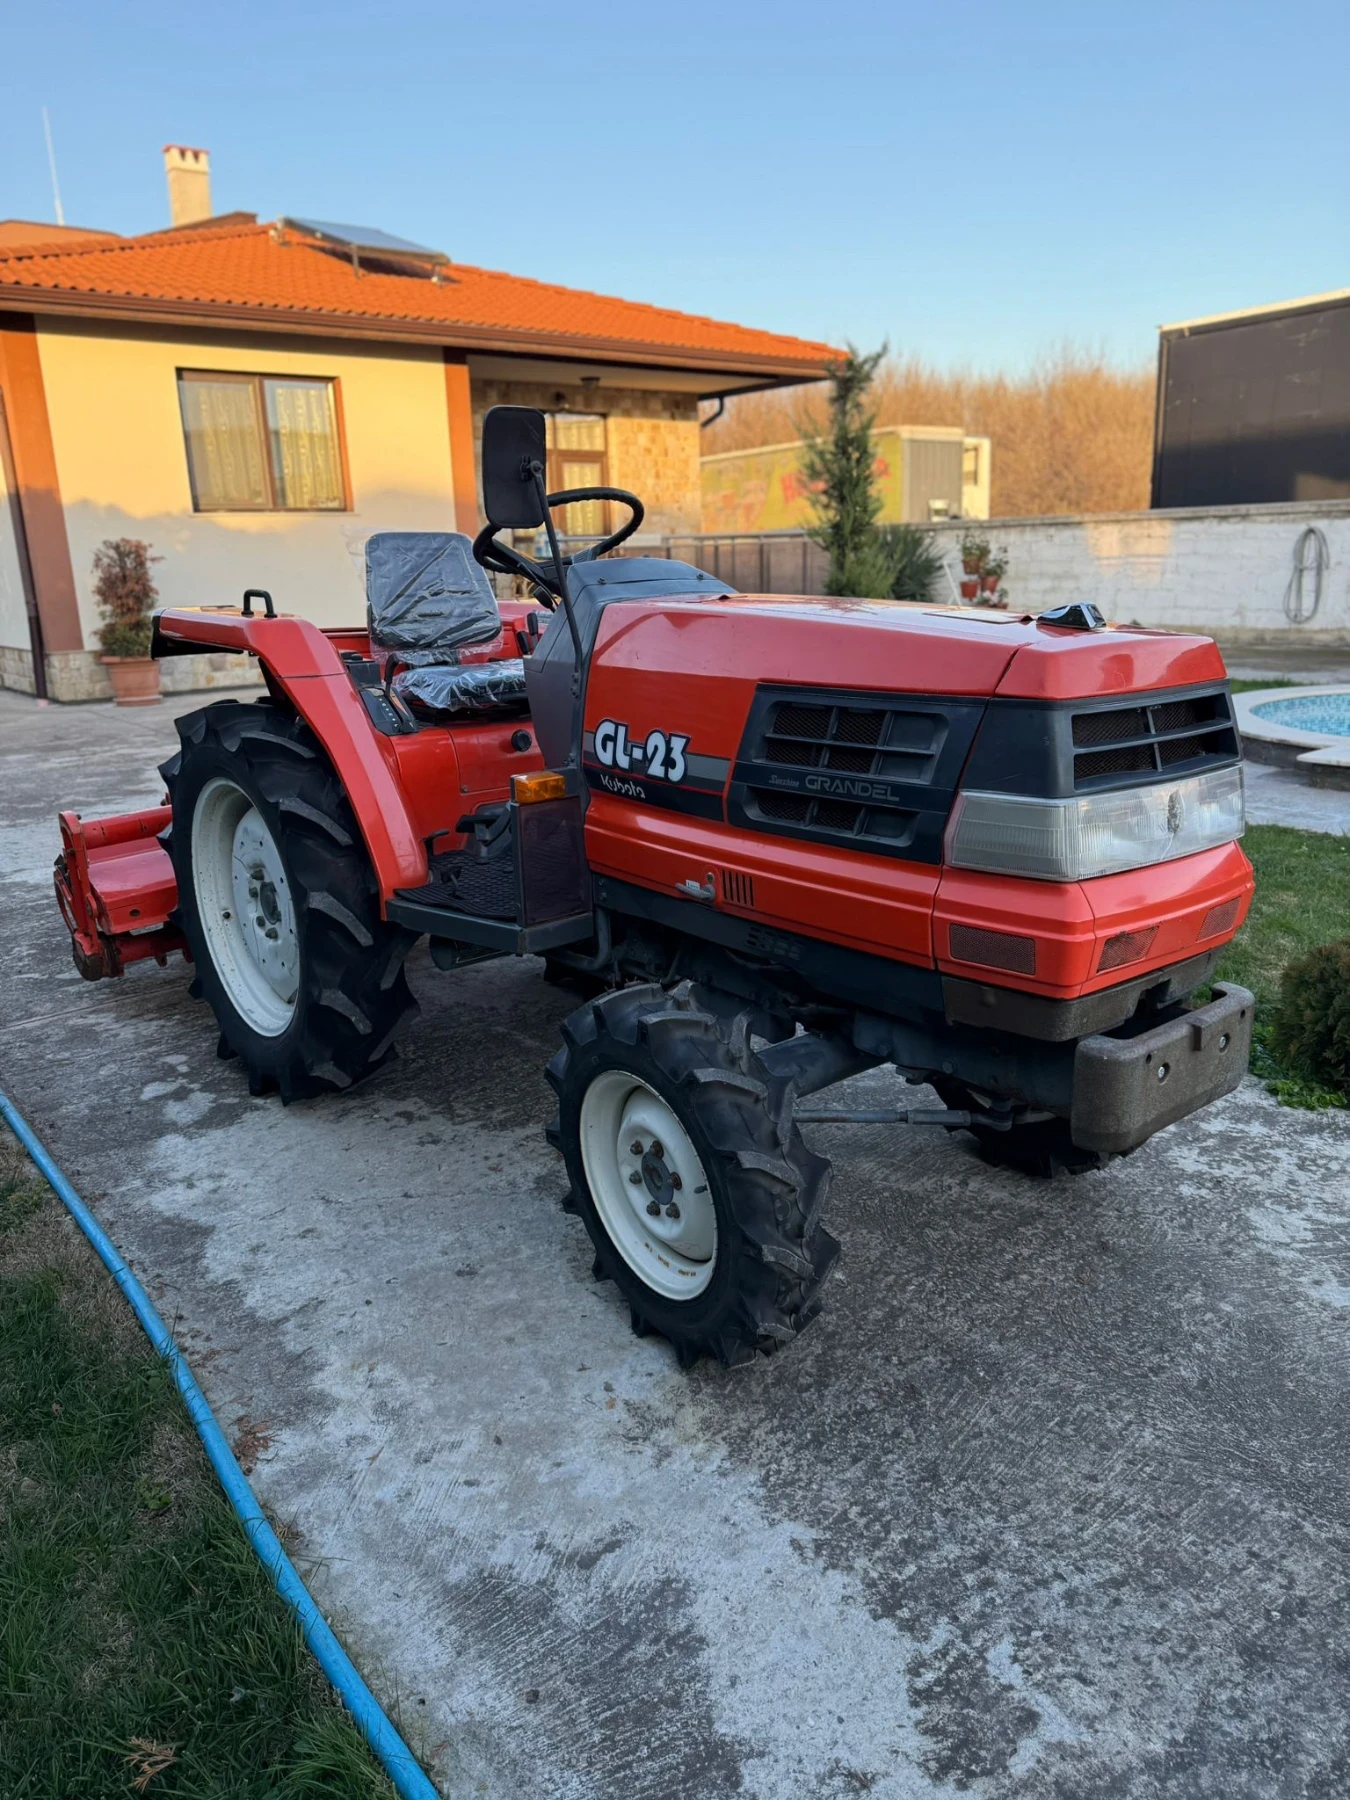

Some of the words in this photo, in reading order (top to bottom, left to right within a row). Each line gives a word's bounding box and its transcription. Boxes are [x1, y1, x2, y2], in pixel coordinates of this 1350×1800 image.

[594, 719, 690, 783] GL-23
[600, 774, 646, 799] Kubota
[805, 775, 900, 802] GRANDEL
